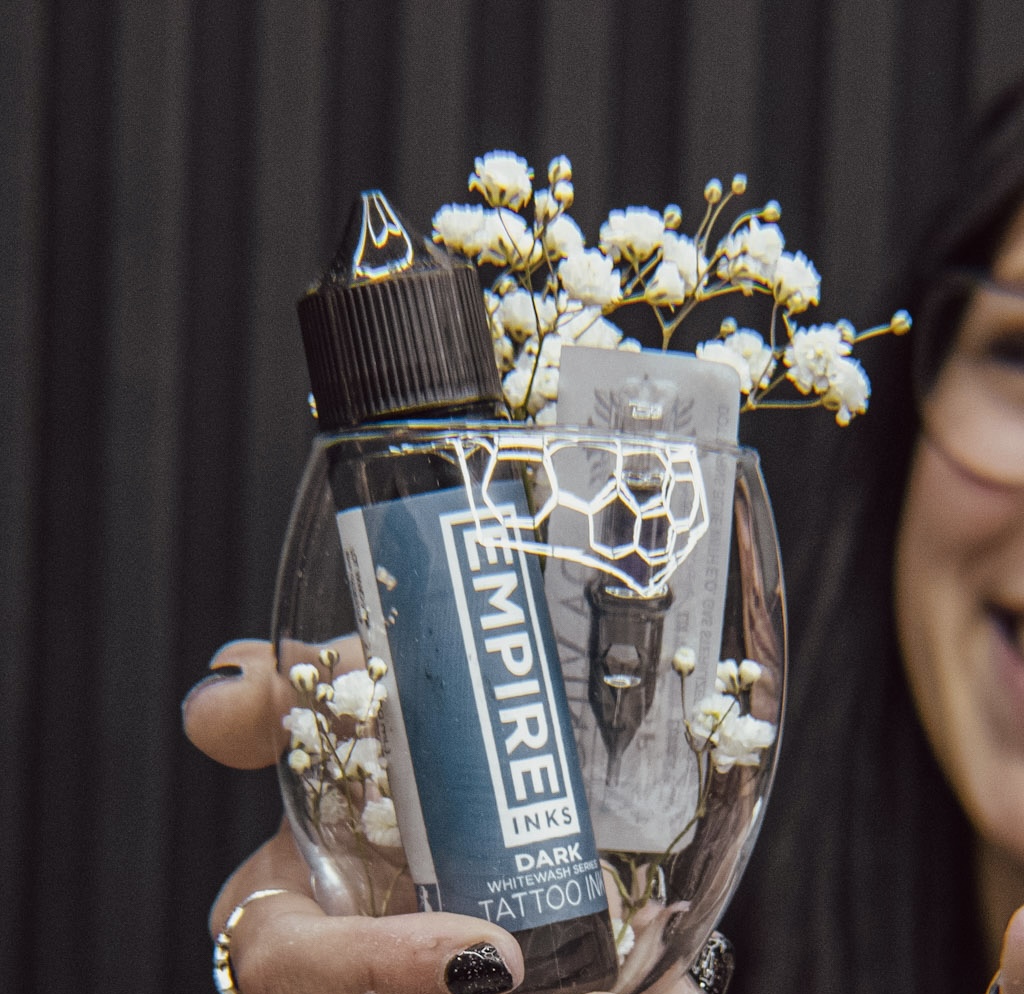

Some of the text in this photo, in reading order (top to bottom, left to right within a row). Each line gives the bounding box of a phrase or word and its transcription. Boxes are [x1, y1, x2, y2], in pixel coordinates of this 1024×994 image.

[463, 525, 561, 801] EMPIRE
[511, 806, 573, 835] INKS
[514, 842, 583, 872] DARK
[486, 866, 572, 894] WHITEWASH
[477, 879, 582, 922] TATTOO
